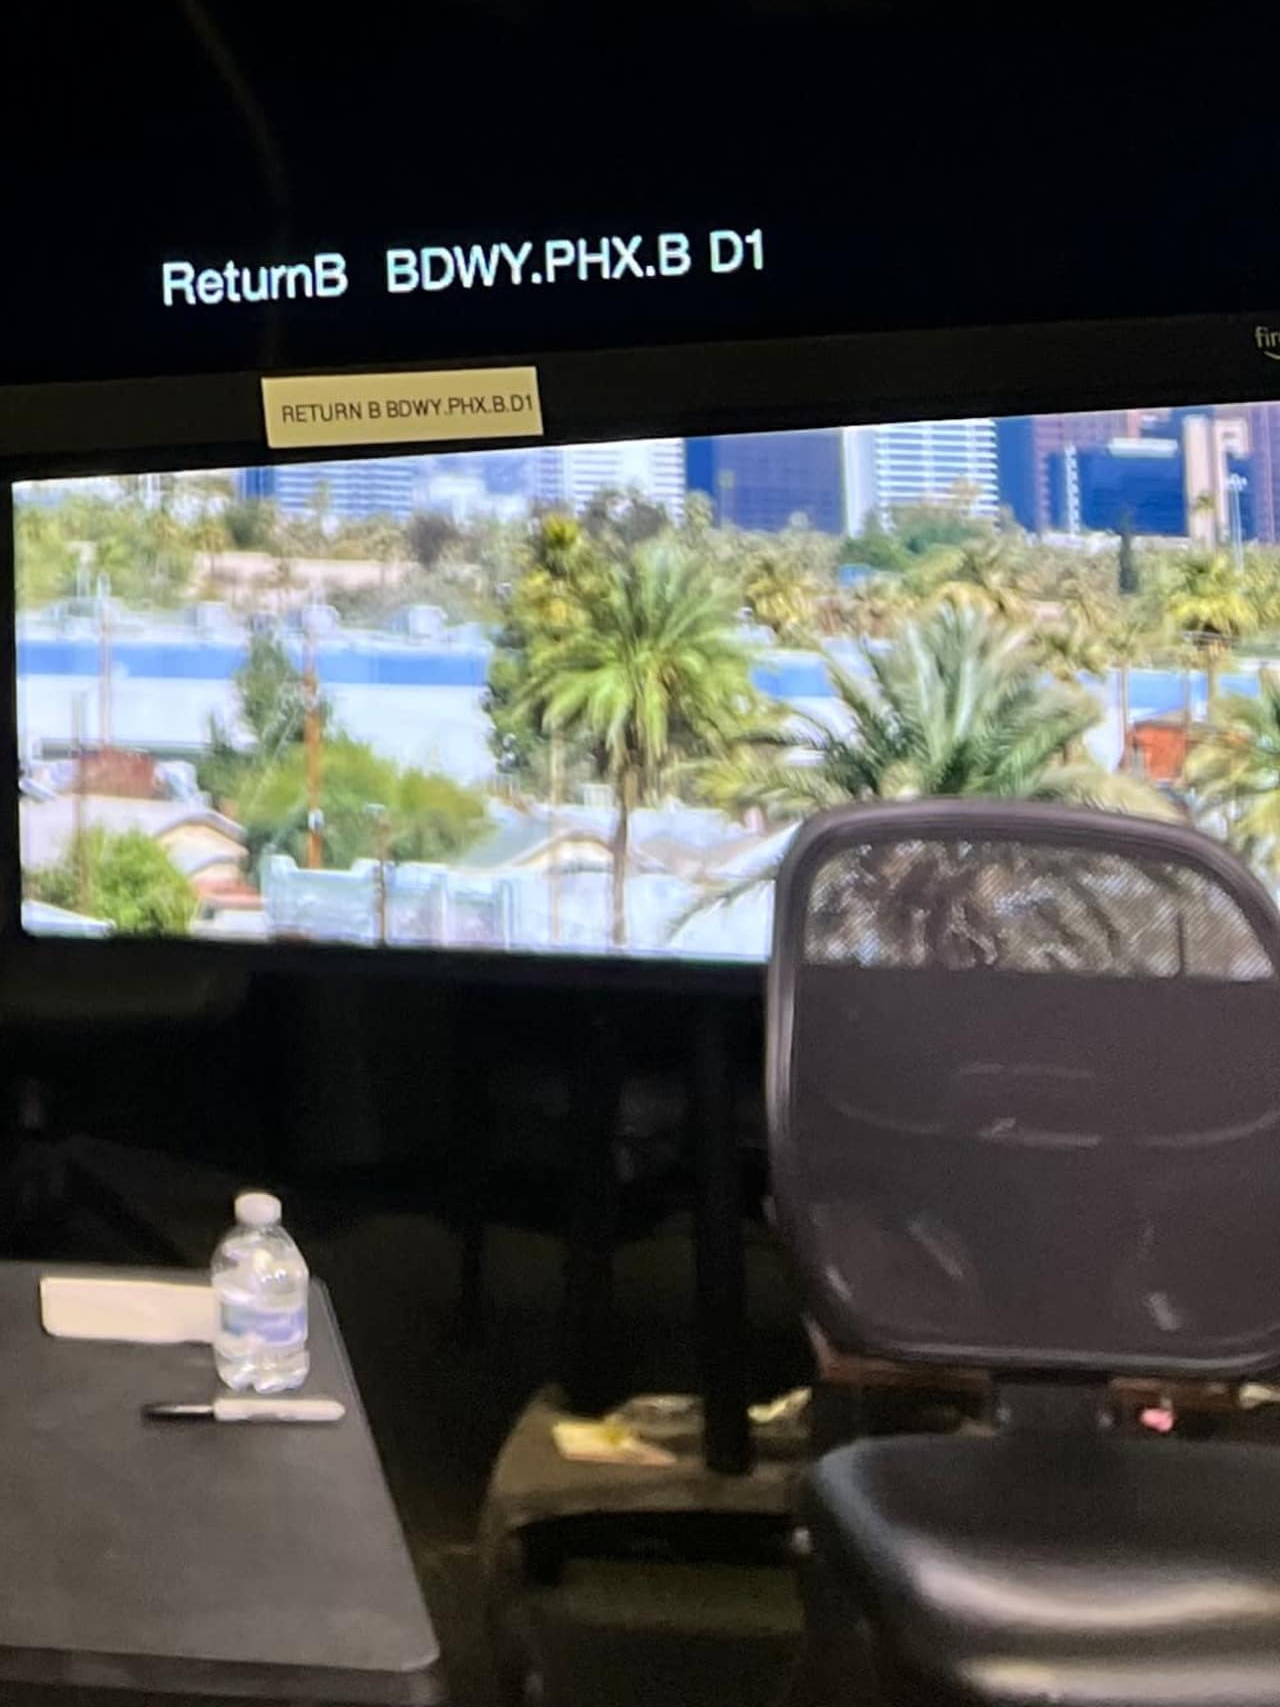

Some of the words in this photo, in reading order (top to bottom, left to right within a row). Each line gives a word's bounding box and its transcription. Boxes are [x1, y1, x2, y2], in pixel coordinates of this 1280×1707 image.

[162, 253, 348, 306] ReturnB
[386, 231, 692, 293] BDWY.PHX.B
[710, 228, 764, 273] D1
[1255, 325, 1280, 349] fir
[282, 402, 363, 423] RETURN
[368, 401, 381, 419] B
[386, 394, 533, 419] BDWY.PHX.B.D1
